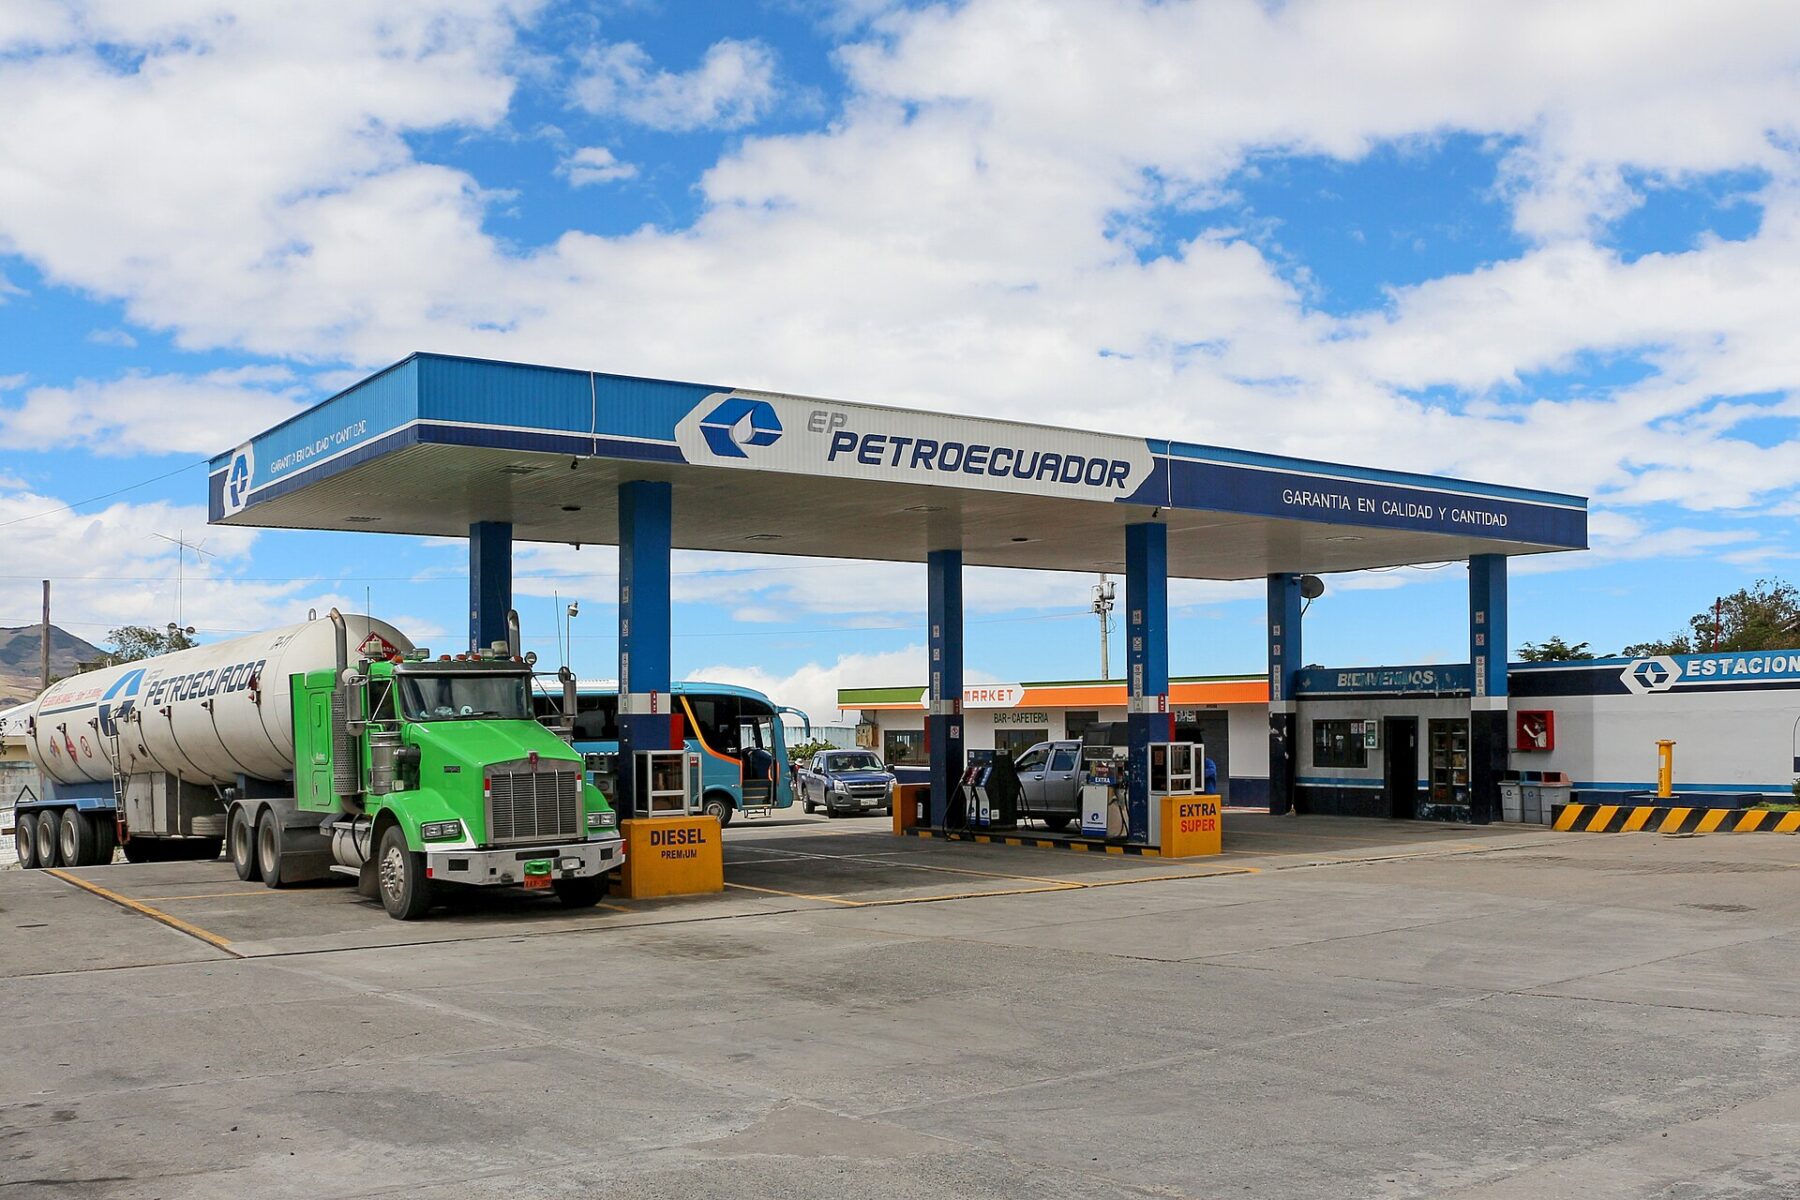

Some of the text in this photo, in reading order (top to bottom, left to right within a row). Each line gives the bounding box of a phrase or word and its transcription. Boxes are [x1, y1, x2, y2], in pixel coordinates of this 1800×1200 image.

[807, 410, 848, 434] EP
[336, 420, 367, 445] CANTDAD
[828, 430, 1131, 489] PETROECUADOR
[1282, 489, 1508, 527] GARANTIA EN CALIDAD Y CANTIDAD
[1686, 655, 1800, 676] ESTACION
[144, 659, 267, 706] PETROECUADOR
[1337, 671, 1434, 687] BIENVENDOS
[964, 689, 1014, 702] MARKET
[994, 712, 1049, 723] BAR-CAFETERIA
[1180, 803, 1217, 817] EXTRA
[1180, 819, 1216, 832] SUPER
[650, 828, 707, 846] DIESEL
